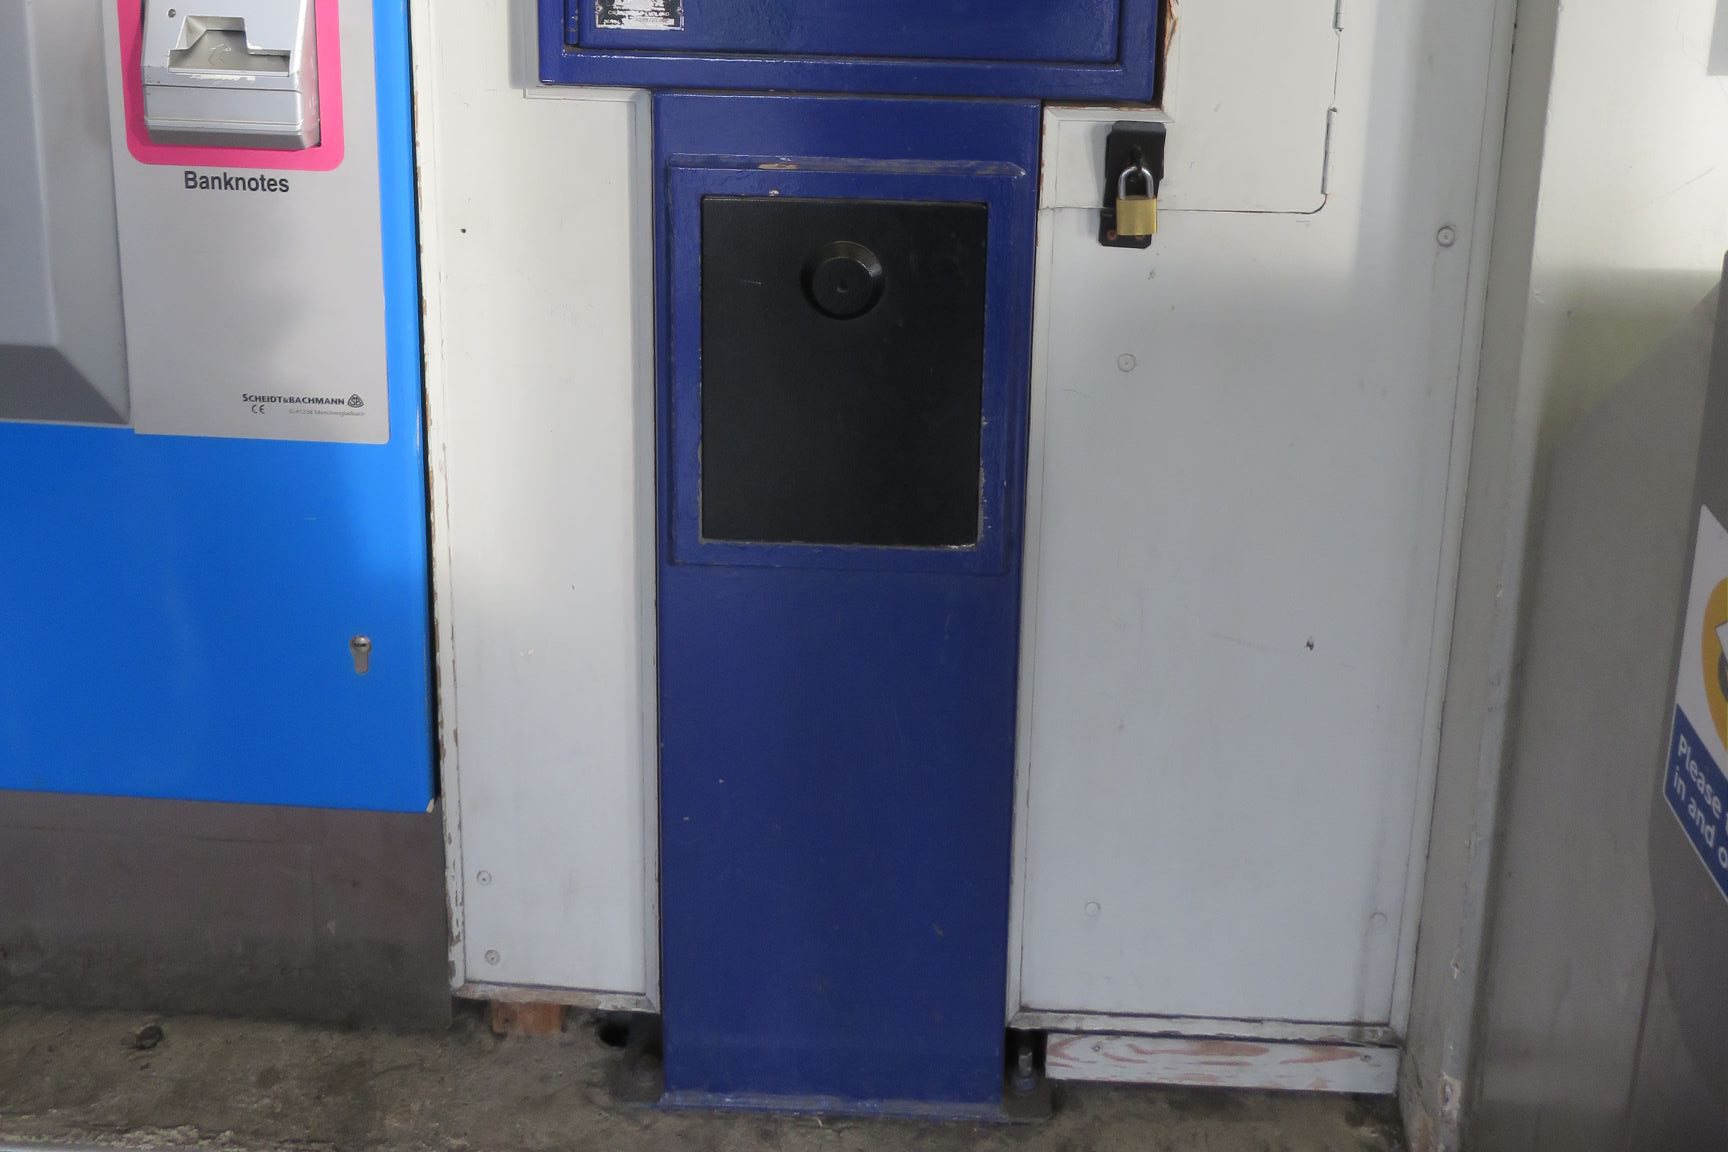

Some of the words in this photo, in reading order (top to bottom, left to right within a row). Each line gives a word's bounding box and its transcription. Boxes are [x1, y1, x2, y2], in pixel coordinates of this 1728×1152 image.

[184, 170, 289, 192] Banknotes
[1674, 766, 1686, 801] in
[1678, 733, 1722, 820] Please
